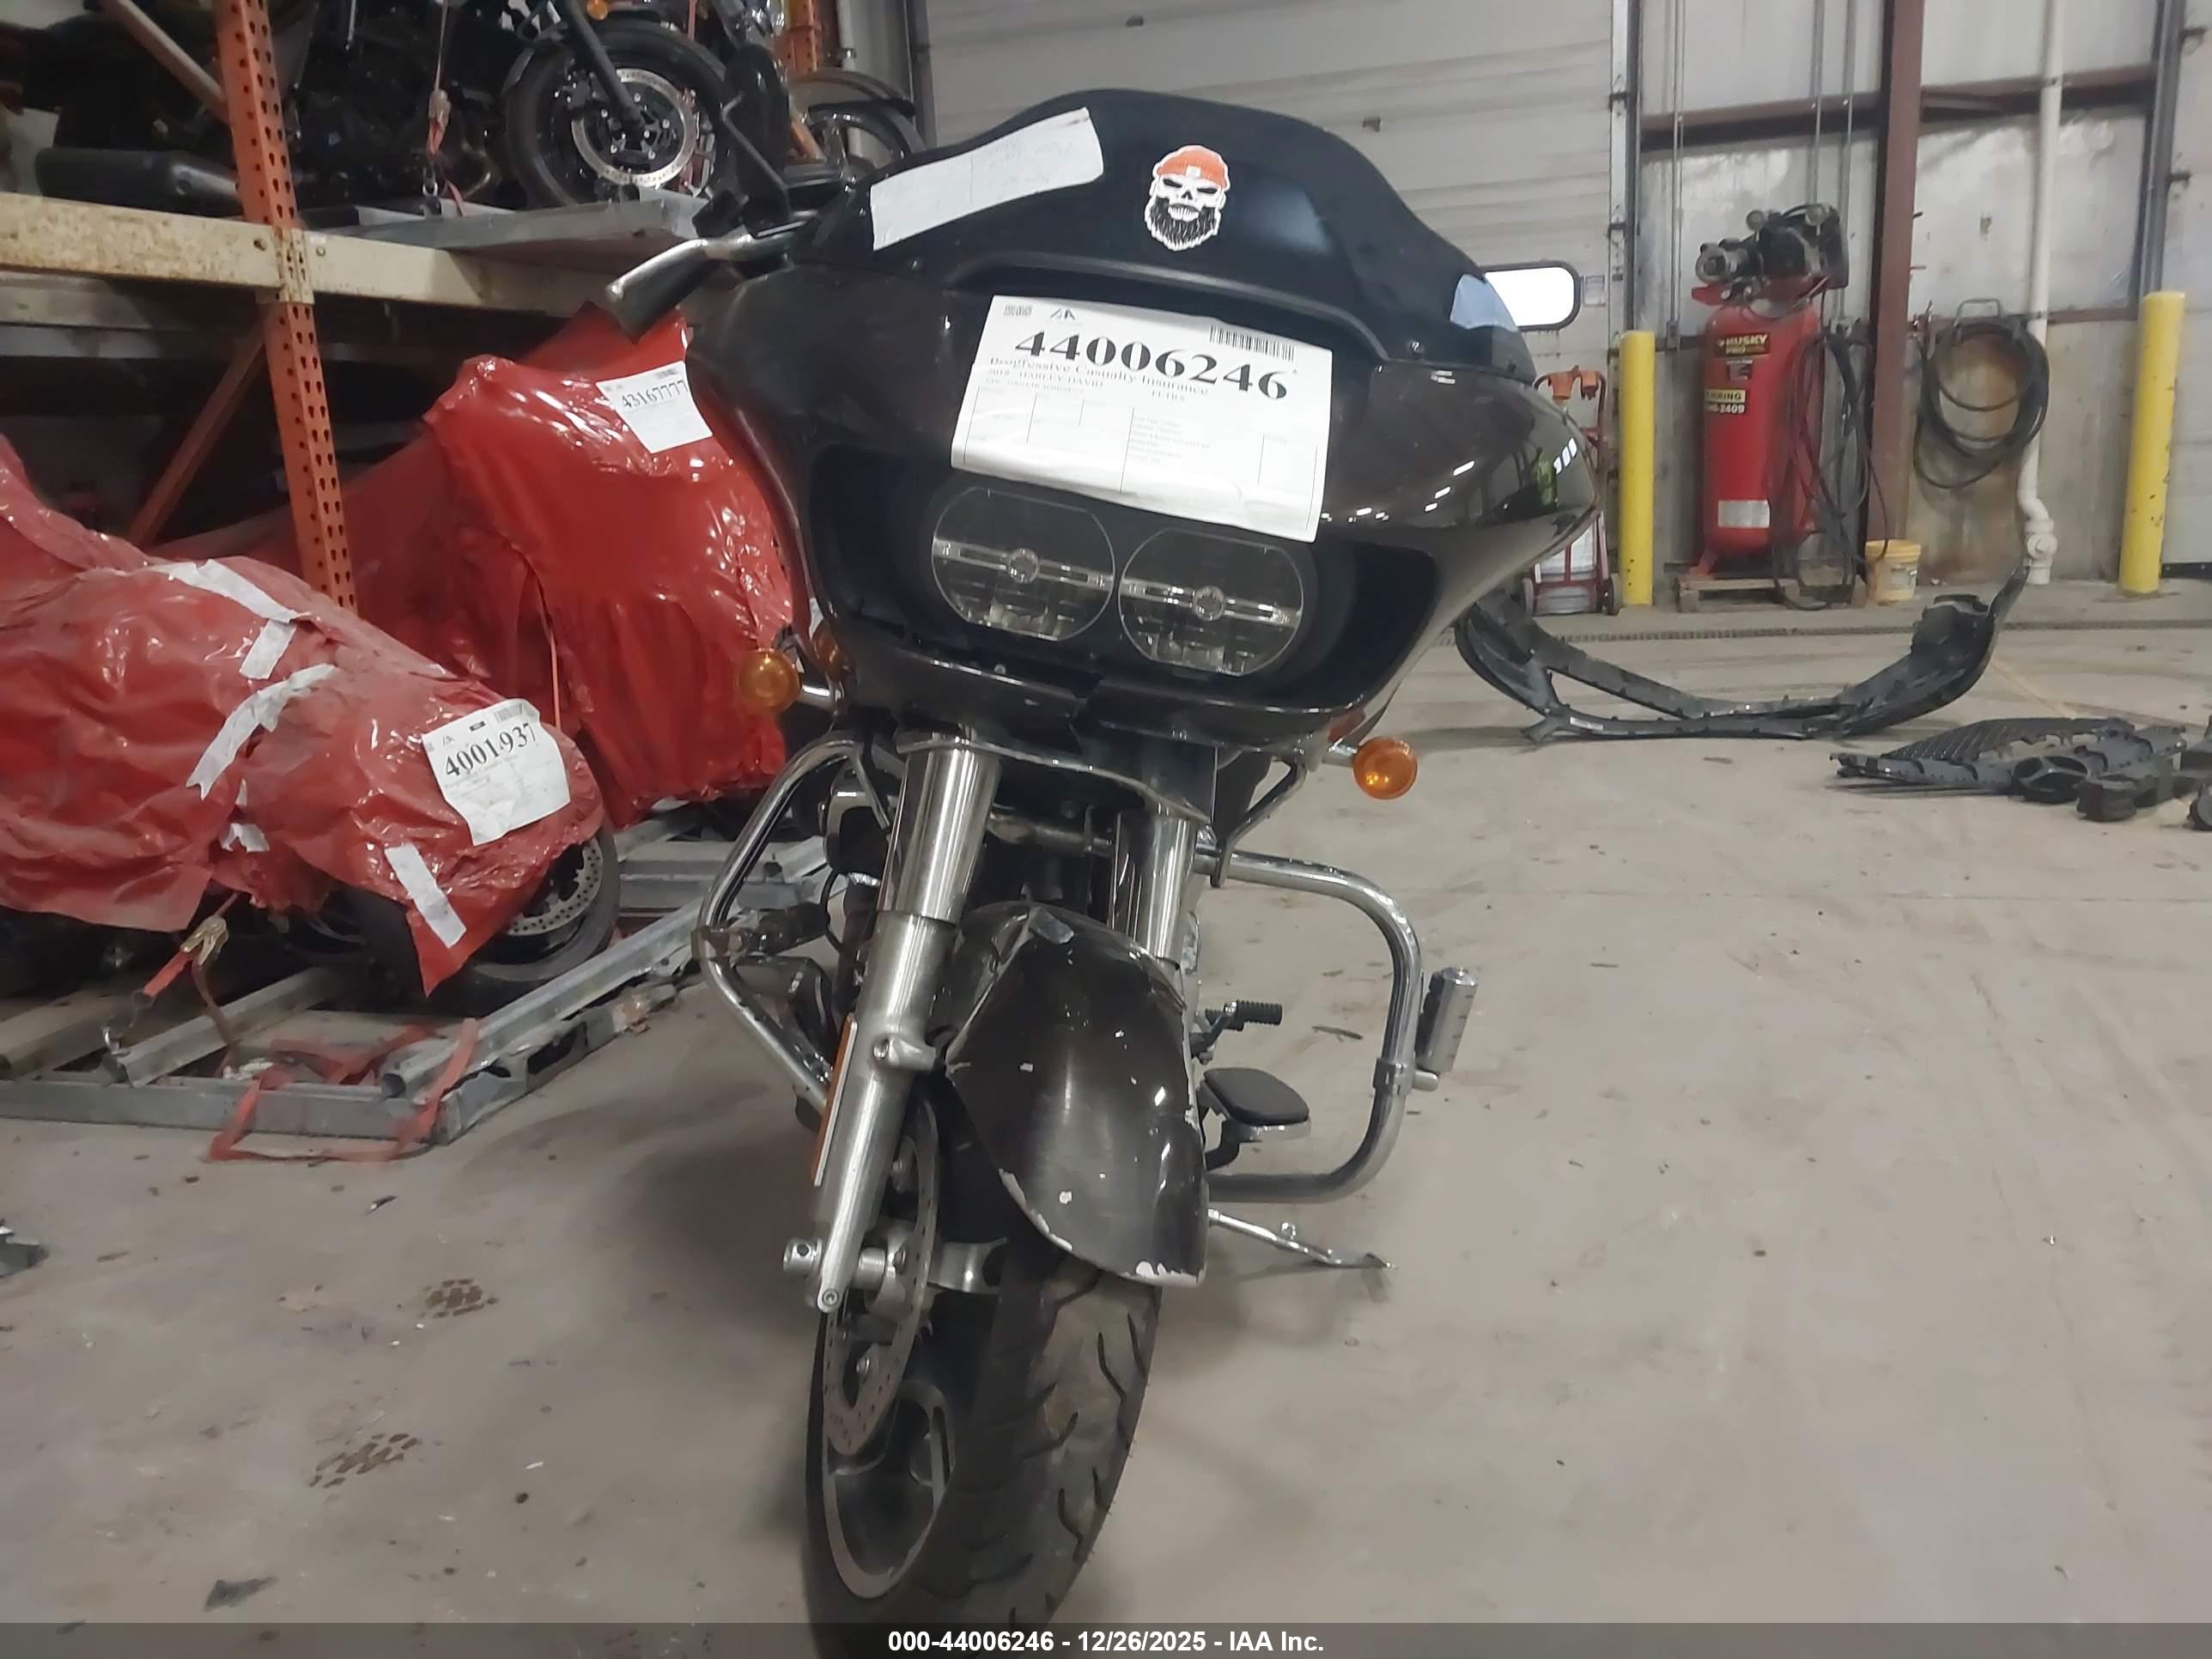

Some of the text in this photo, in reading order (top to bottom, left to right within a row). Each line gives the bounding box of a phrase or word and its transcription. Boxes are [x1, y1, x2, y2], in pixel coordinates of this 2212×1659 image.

[1725, 334, 1767, 345] HUSKY
[1015, 330, 1288, 401] 44006246
[621, 380, 689, 409] 43167777
